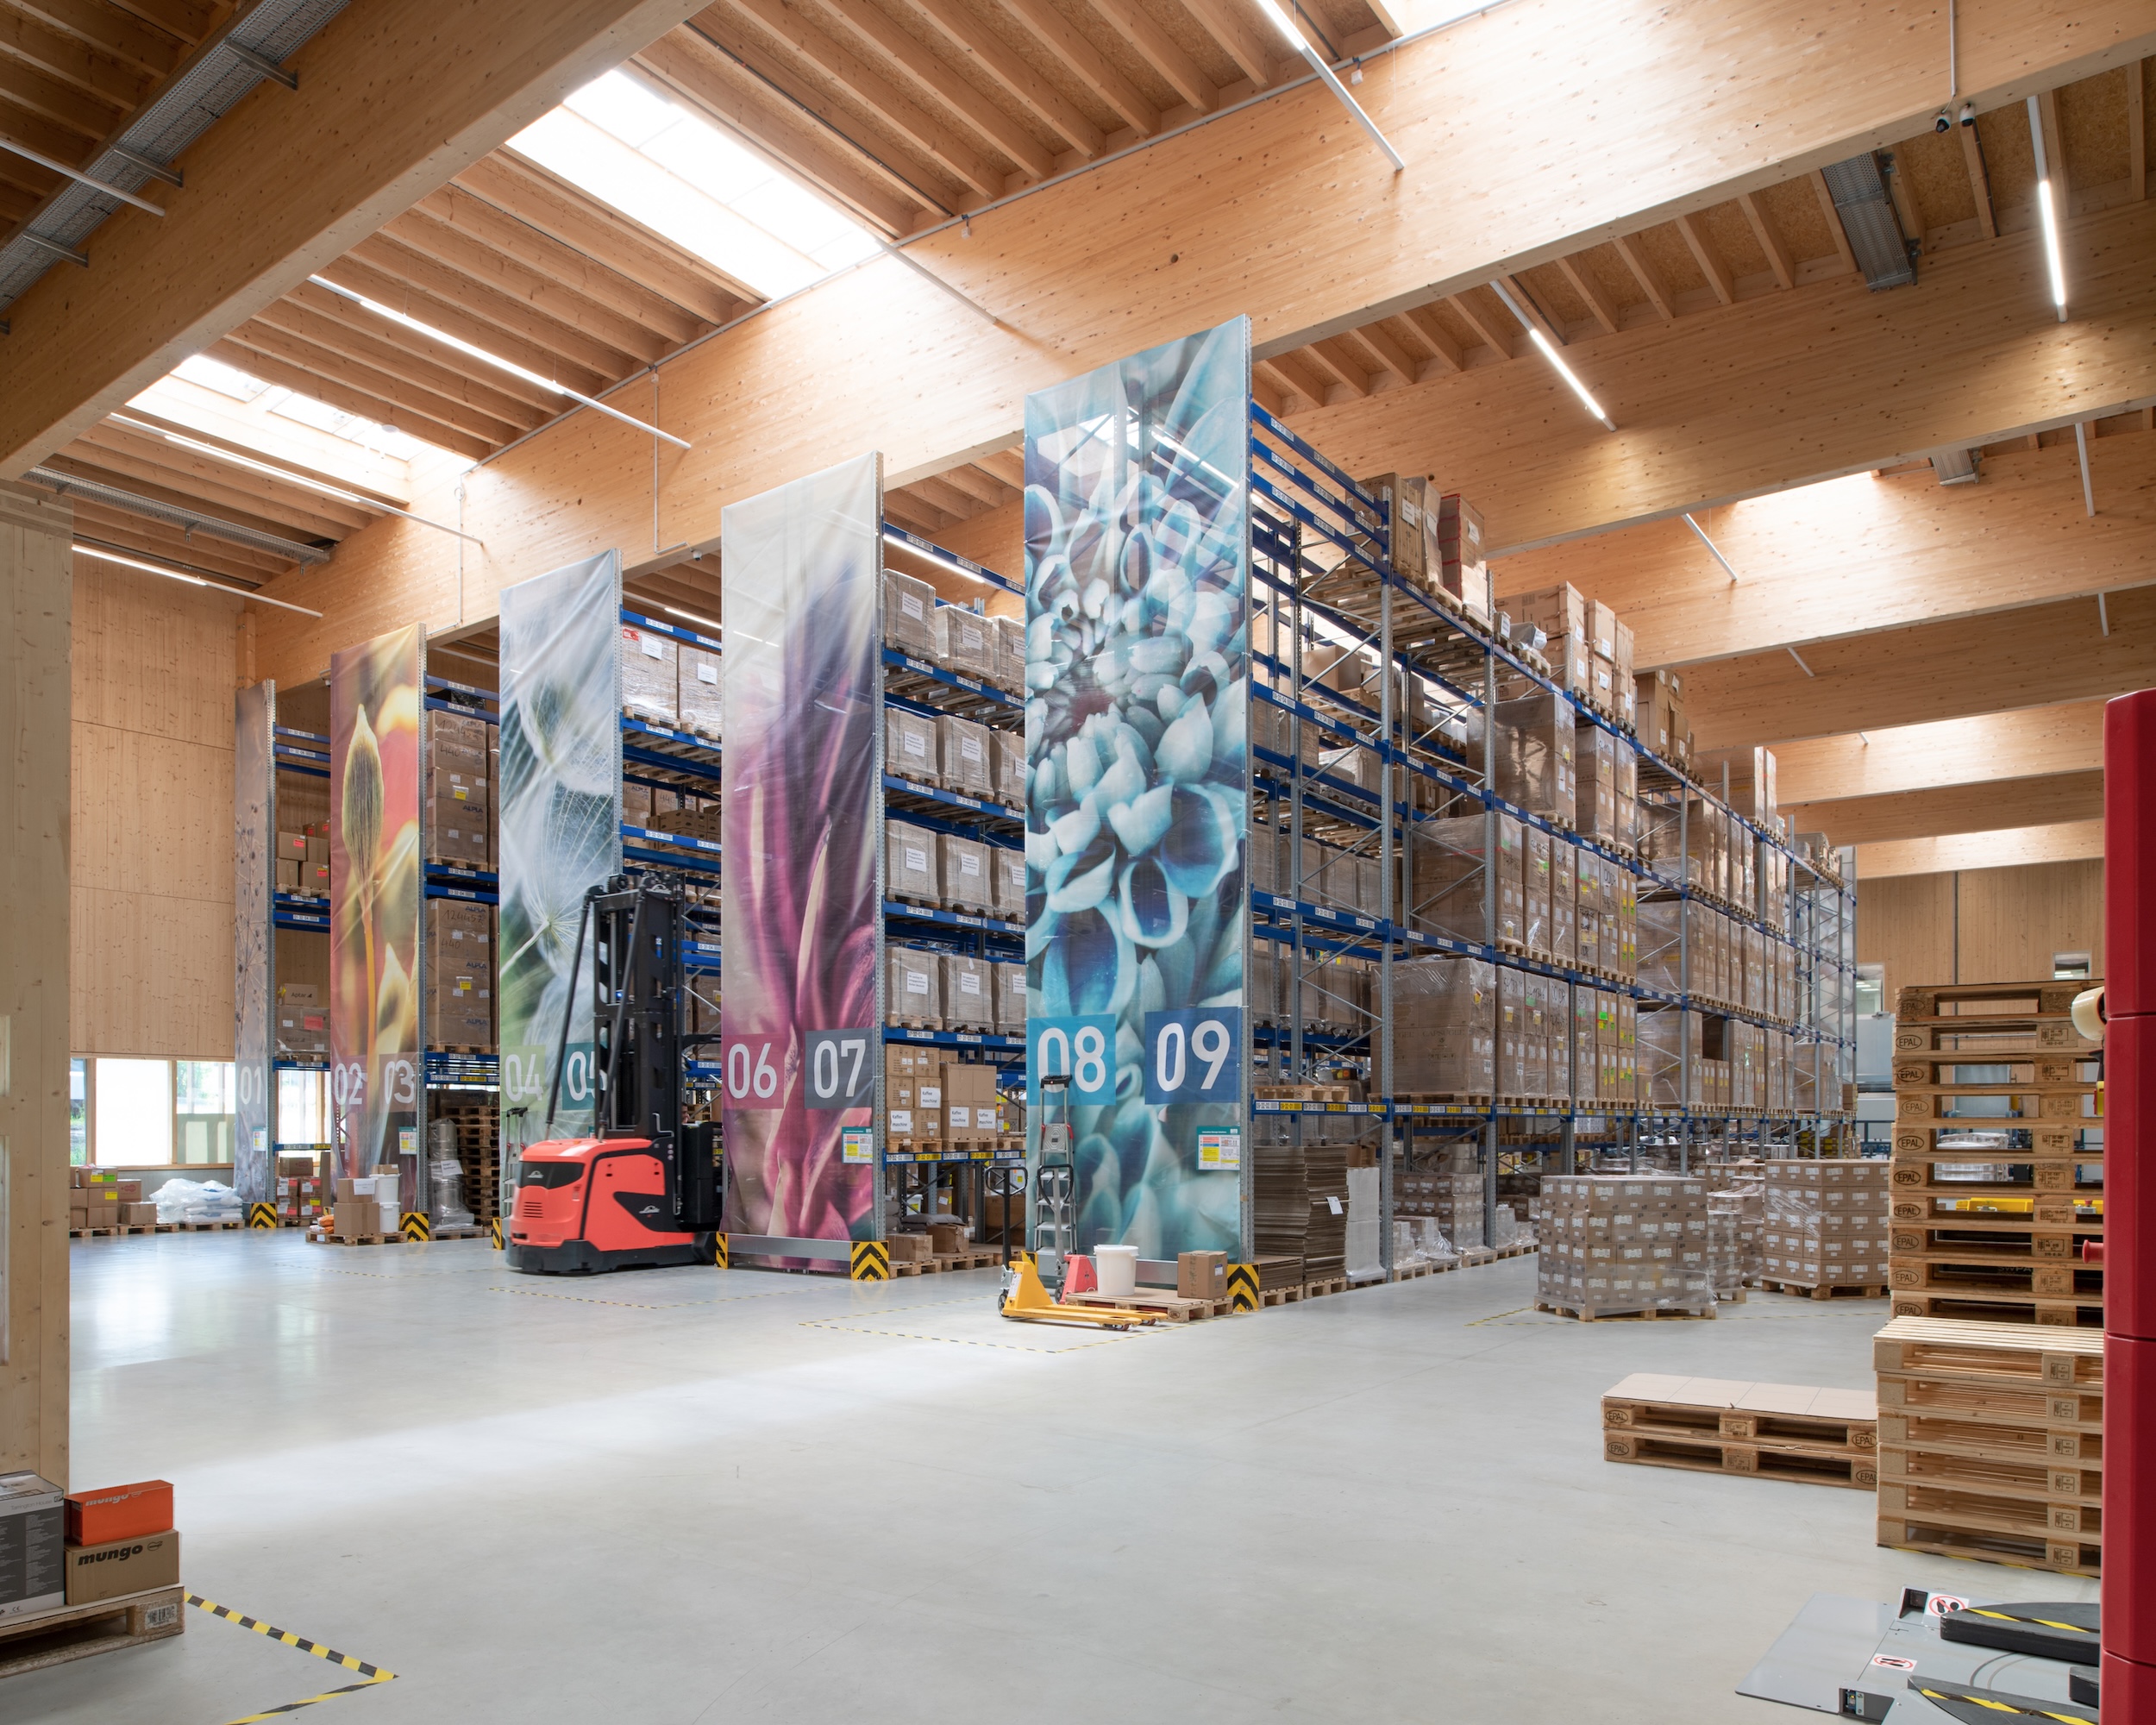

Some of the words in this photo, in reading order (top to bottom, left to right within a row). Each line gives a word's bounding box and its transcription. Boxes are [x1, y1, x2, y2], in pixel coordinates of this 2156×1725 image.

[505, 1054, 543, 1101] 04
[727, 1043, 777, 1099] 06
[812, 1039, 867, 1097] 07
[1037, 1026, 1106, 1093] 08
[1156, 1019, 1231, 1092] 09
[241, 1066, 261, 1105] 01
[335, 1063, 363, 1105] 02
[384, 1060, 415, 1104] 03
[85, 1493, 129, 1507] mungo
[78, 1545, 143, 1566] mungo
